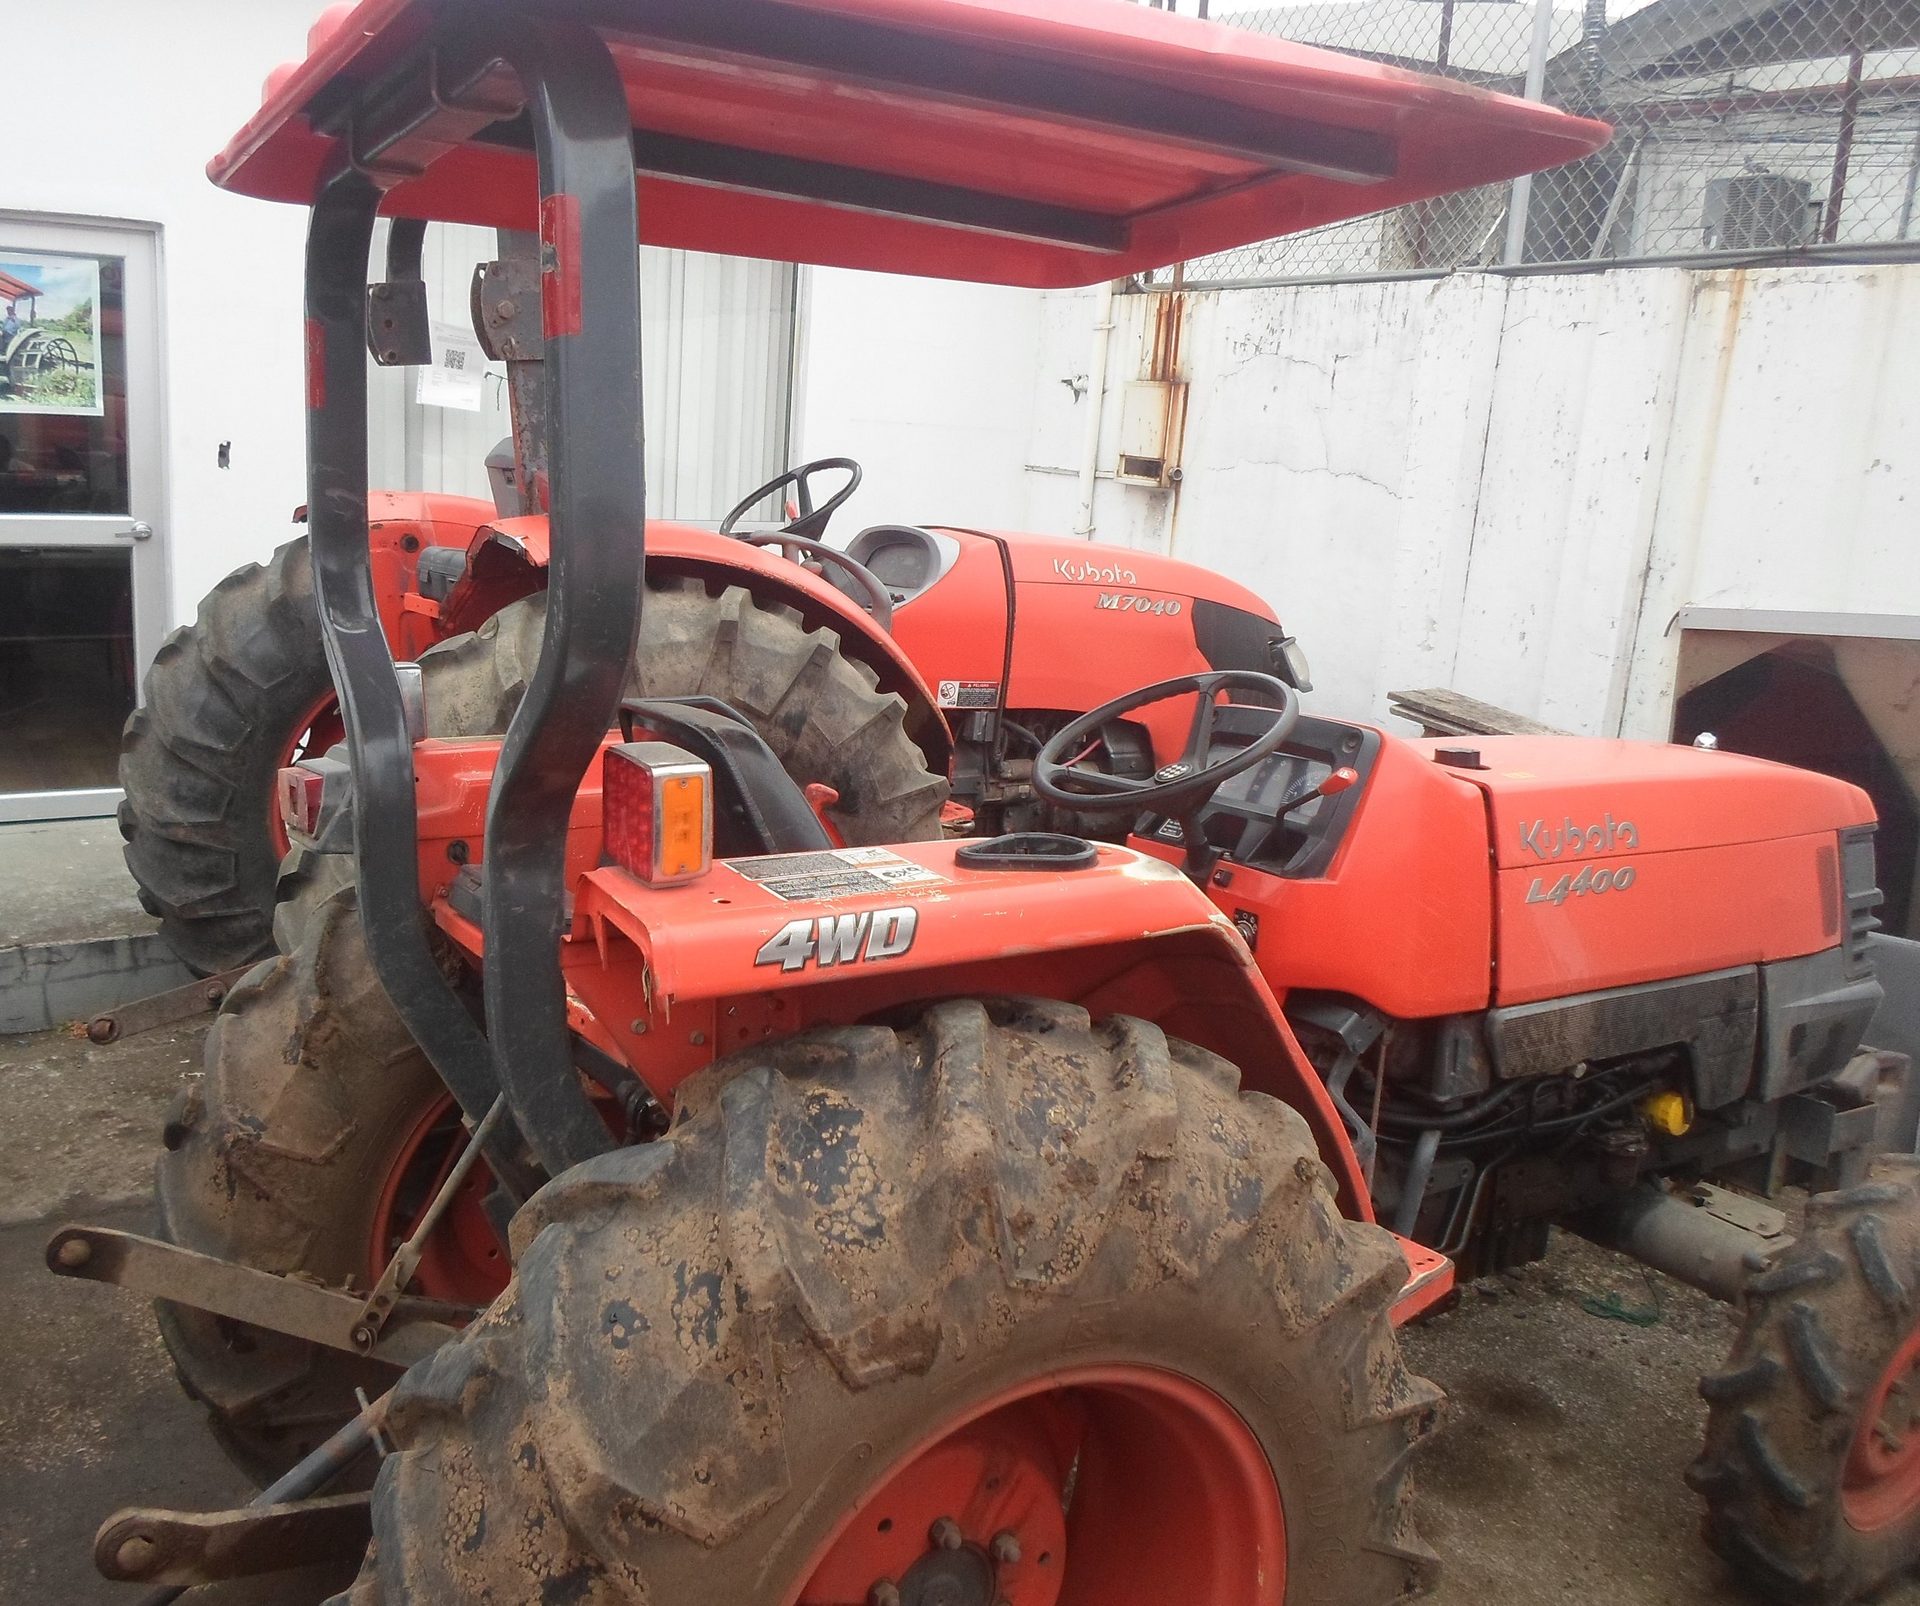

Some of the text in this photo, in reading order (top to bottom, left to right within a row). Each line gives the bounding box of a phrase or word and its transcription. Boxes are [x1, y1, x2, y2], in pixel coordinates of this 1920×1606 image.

[1052, 558, 1137, 584] Kubota
[1096, 592, 1182, 616] M7040
[1519, 812, 1639, 859] Kubota
[1525, 865, 1636, 906] L4400
[754, 906, 919, 973] 4WD
